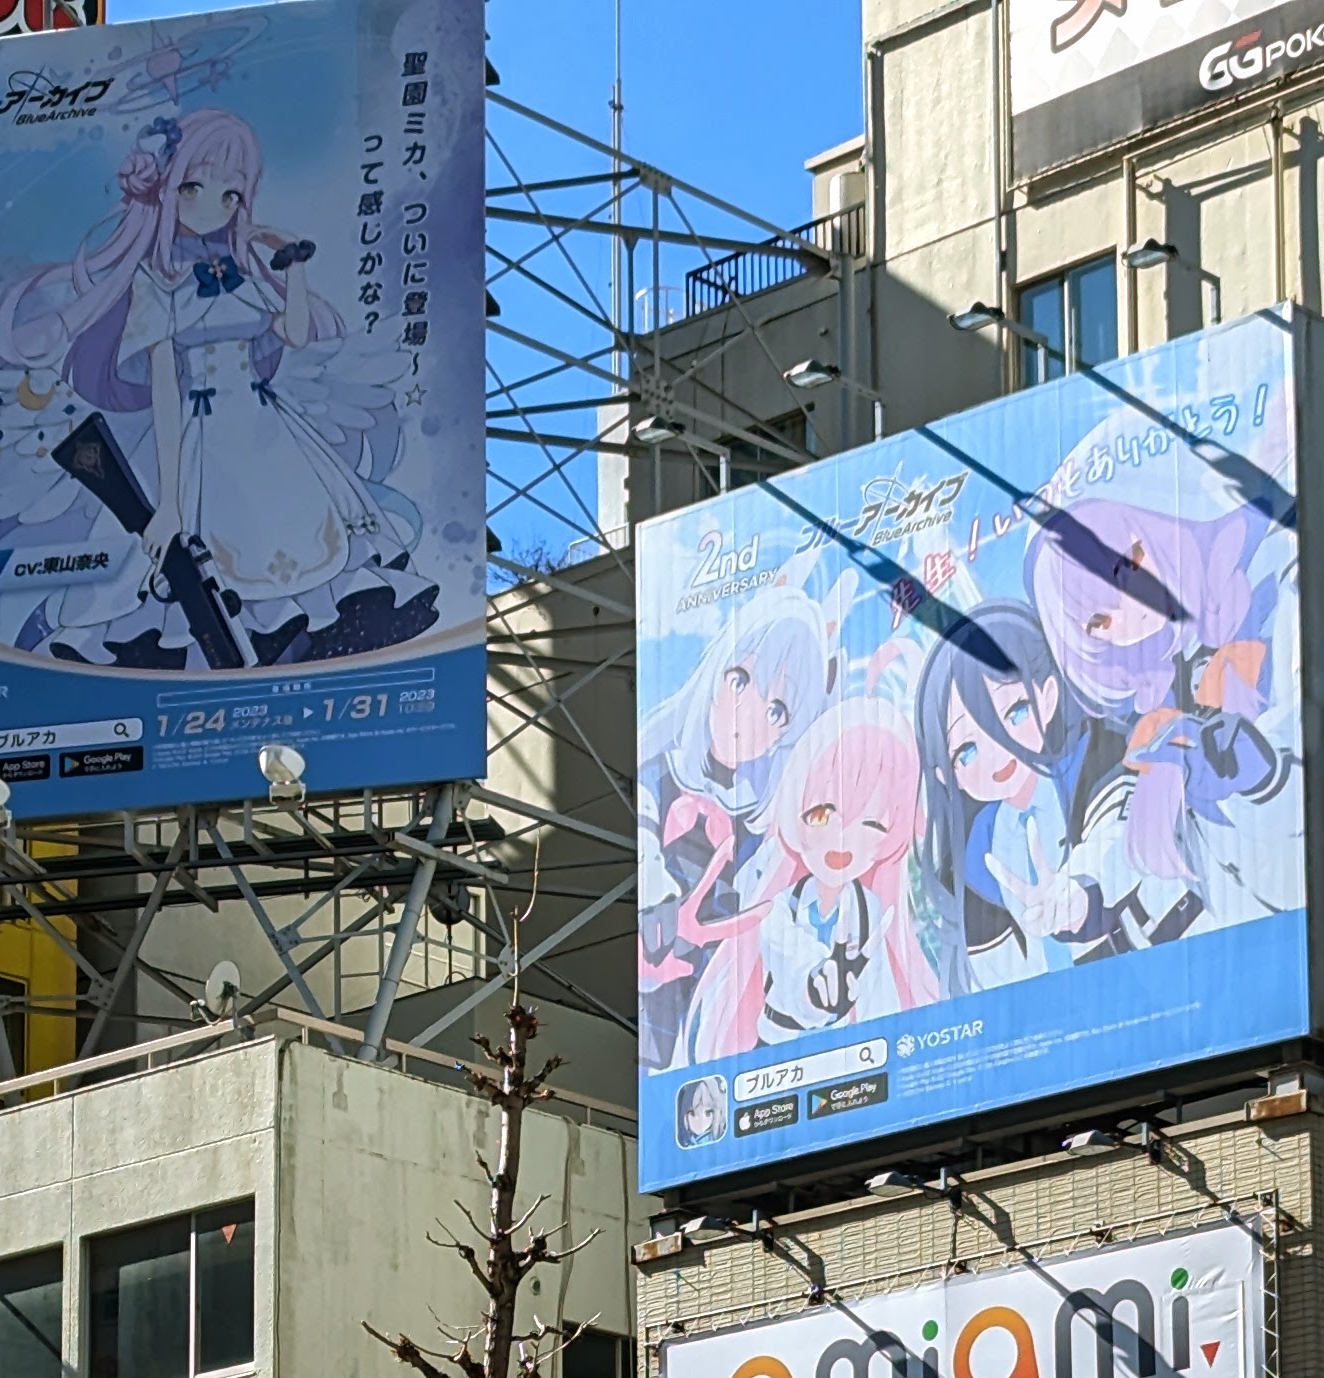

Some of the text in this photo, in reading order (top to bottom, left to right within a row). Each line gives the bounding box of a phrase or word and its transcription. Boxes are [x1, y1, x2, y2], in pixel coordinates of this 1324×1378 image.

[691, 530, 760, 588] 2nd
[676, 566, 778, 616] ANNIVERSARY
[323, 693, 388, 722] 1/31
[157, 709, 225, 738] 1/24
[2, 759, 46, 772] App Store
[917, 1020, 984, 1050] YOSTAR
[746, 1065, 804, 1094] ブルアカ
